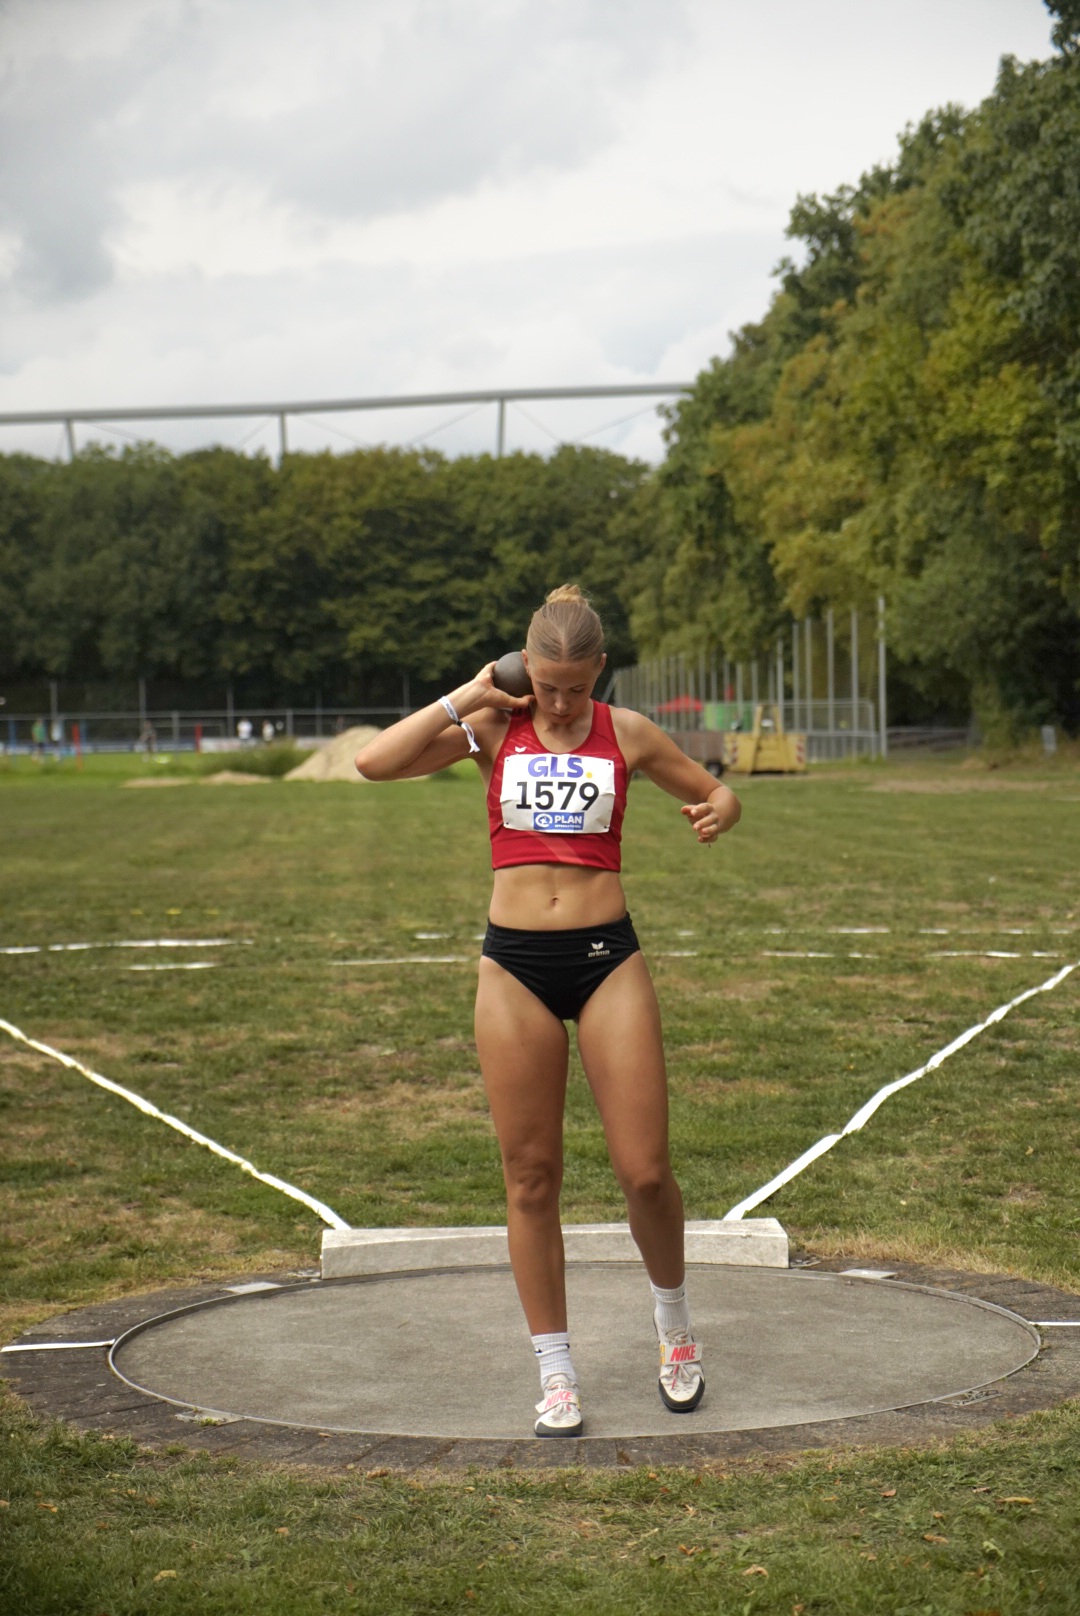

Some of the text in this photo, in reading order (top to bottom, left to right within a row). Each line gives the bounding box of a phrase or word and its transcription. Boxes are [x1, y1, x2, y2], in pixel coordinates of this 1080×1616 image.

[516, 781, 600, 811] 1579
[554, 815, 583, 824] PLAN
[670, 1344, 696, 1361] NIKE
[544, 1390, 573, 1409] NIKE
